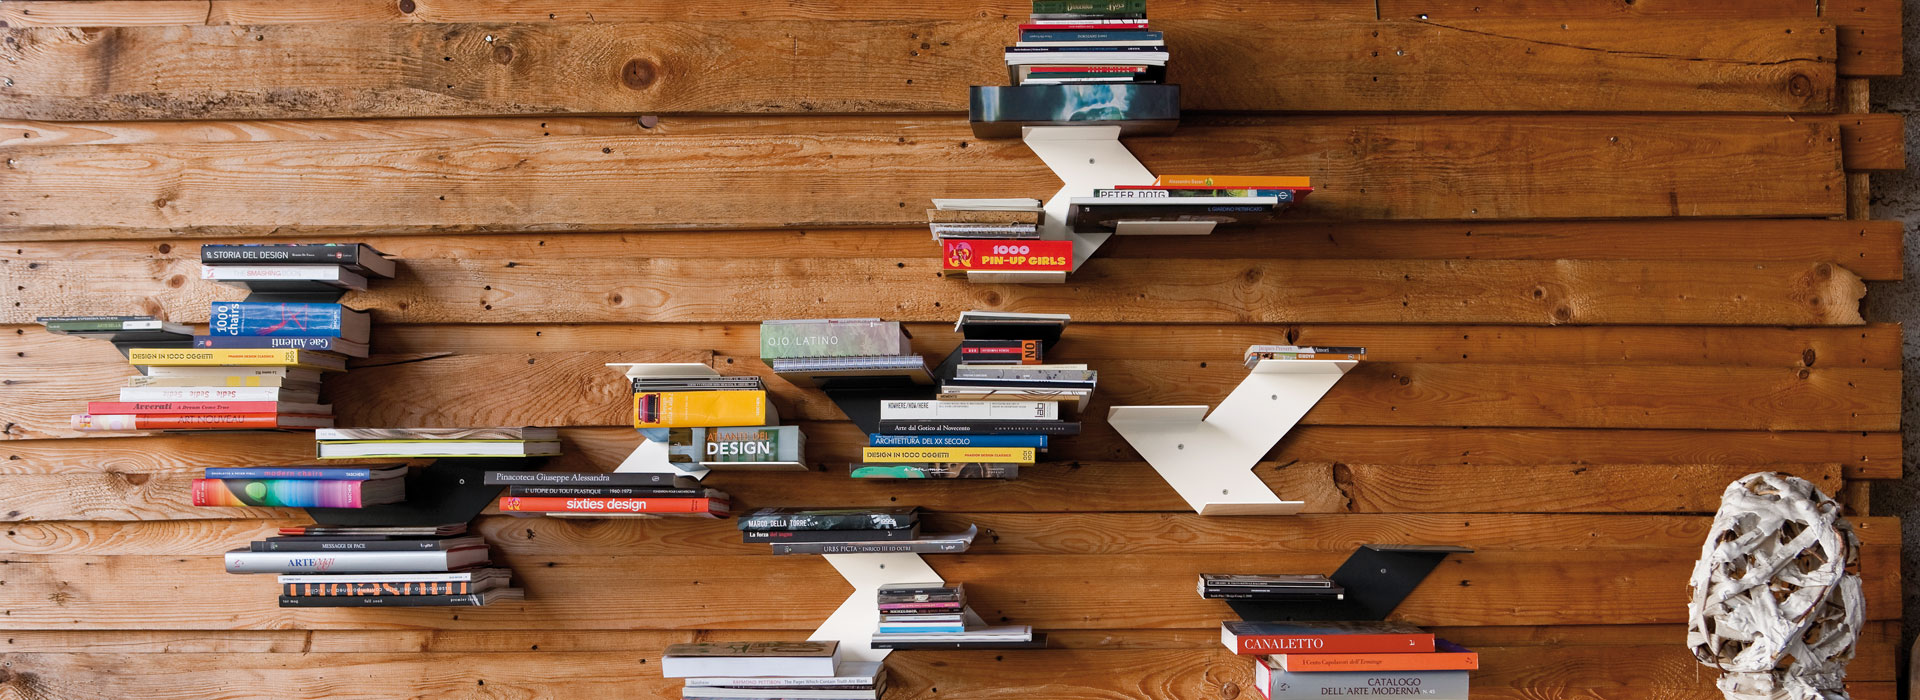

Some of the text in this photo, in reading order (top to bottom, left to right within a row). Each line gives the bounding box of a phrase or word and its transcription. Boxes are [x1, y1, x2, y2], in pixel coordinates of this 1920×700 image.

[213, 251, 241, 259] STORIA
[243, 251, 258, 259] DEL
[260, 251, 289, 259] DESIGN
[993, 245, 1030, 255] 1000
[982, 256, 1066, 265] PIN-UP GIRLS
[217, 305, 228, 333] 1000
[228, 303, 240, 336] chairs
[272, 338, 328, 348] Gae Aulenti
[767, 336, 839, 346] OJO LATINO
[178, 415, 245, 424] ART NOUVEAU
[752, 432, 769, 441] DEL
[707, 441, 770, 455] DESIGN
[496, 473, 610, 483] Pinacoteca Giuseppe Alessandra
[566, 498, 647, 511] sixties design
[748, 520, 768, 528] MARCO
[1244, 638, 1324, 650] CANALETTO
[1367, 678, 1421, 687] CATALOGO
[1321, 687, 1369, 695] DELL'ARTE
[1371, 687, 1421, 695] MODERNA
